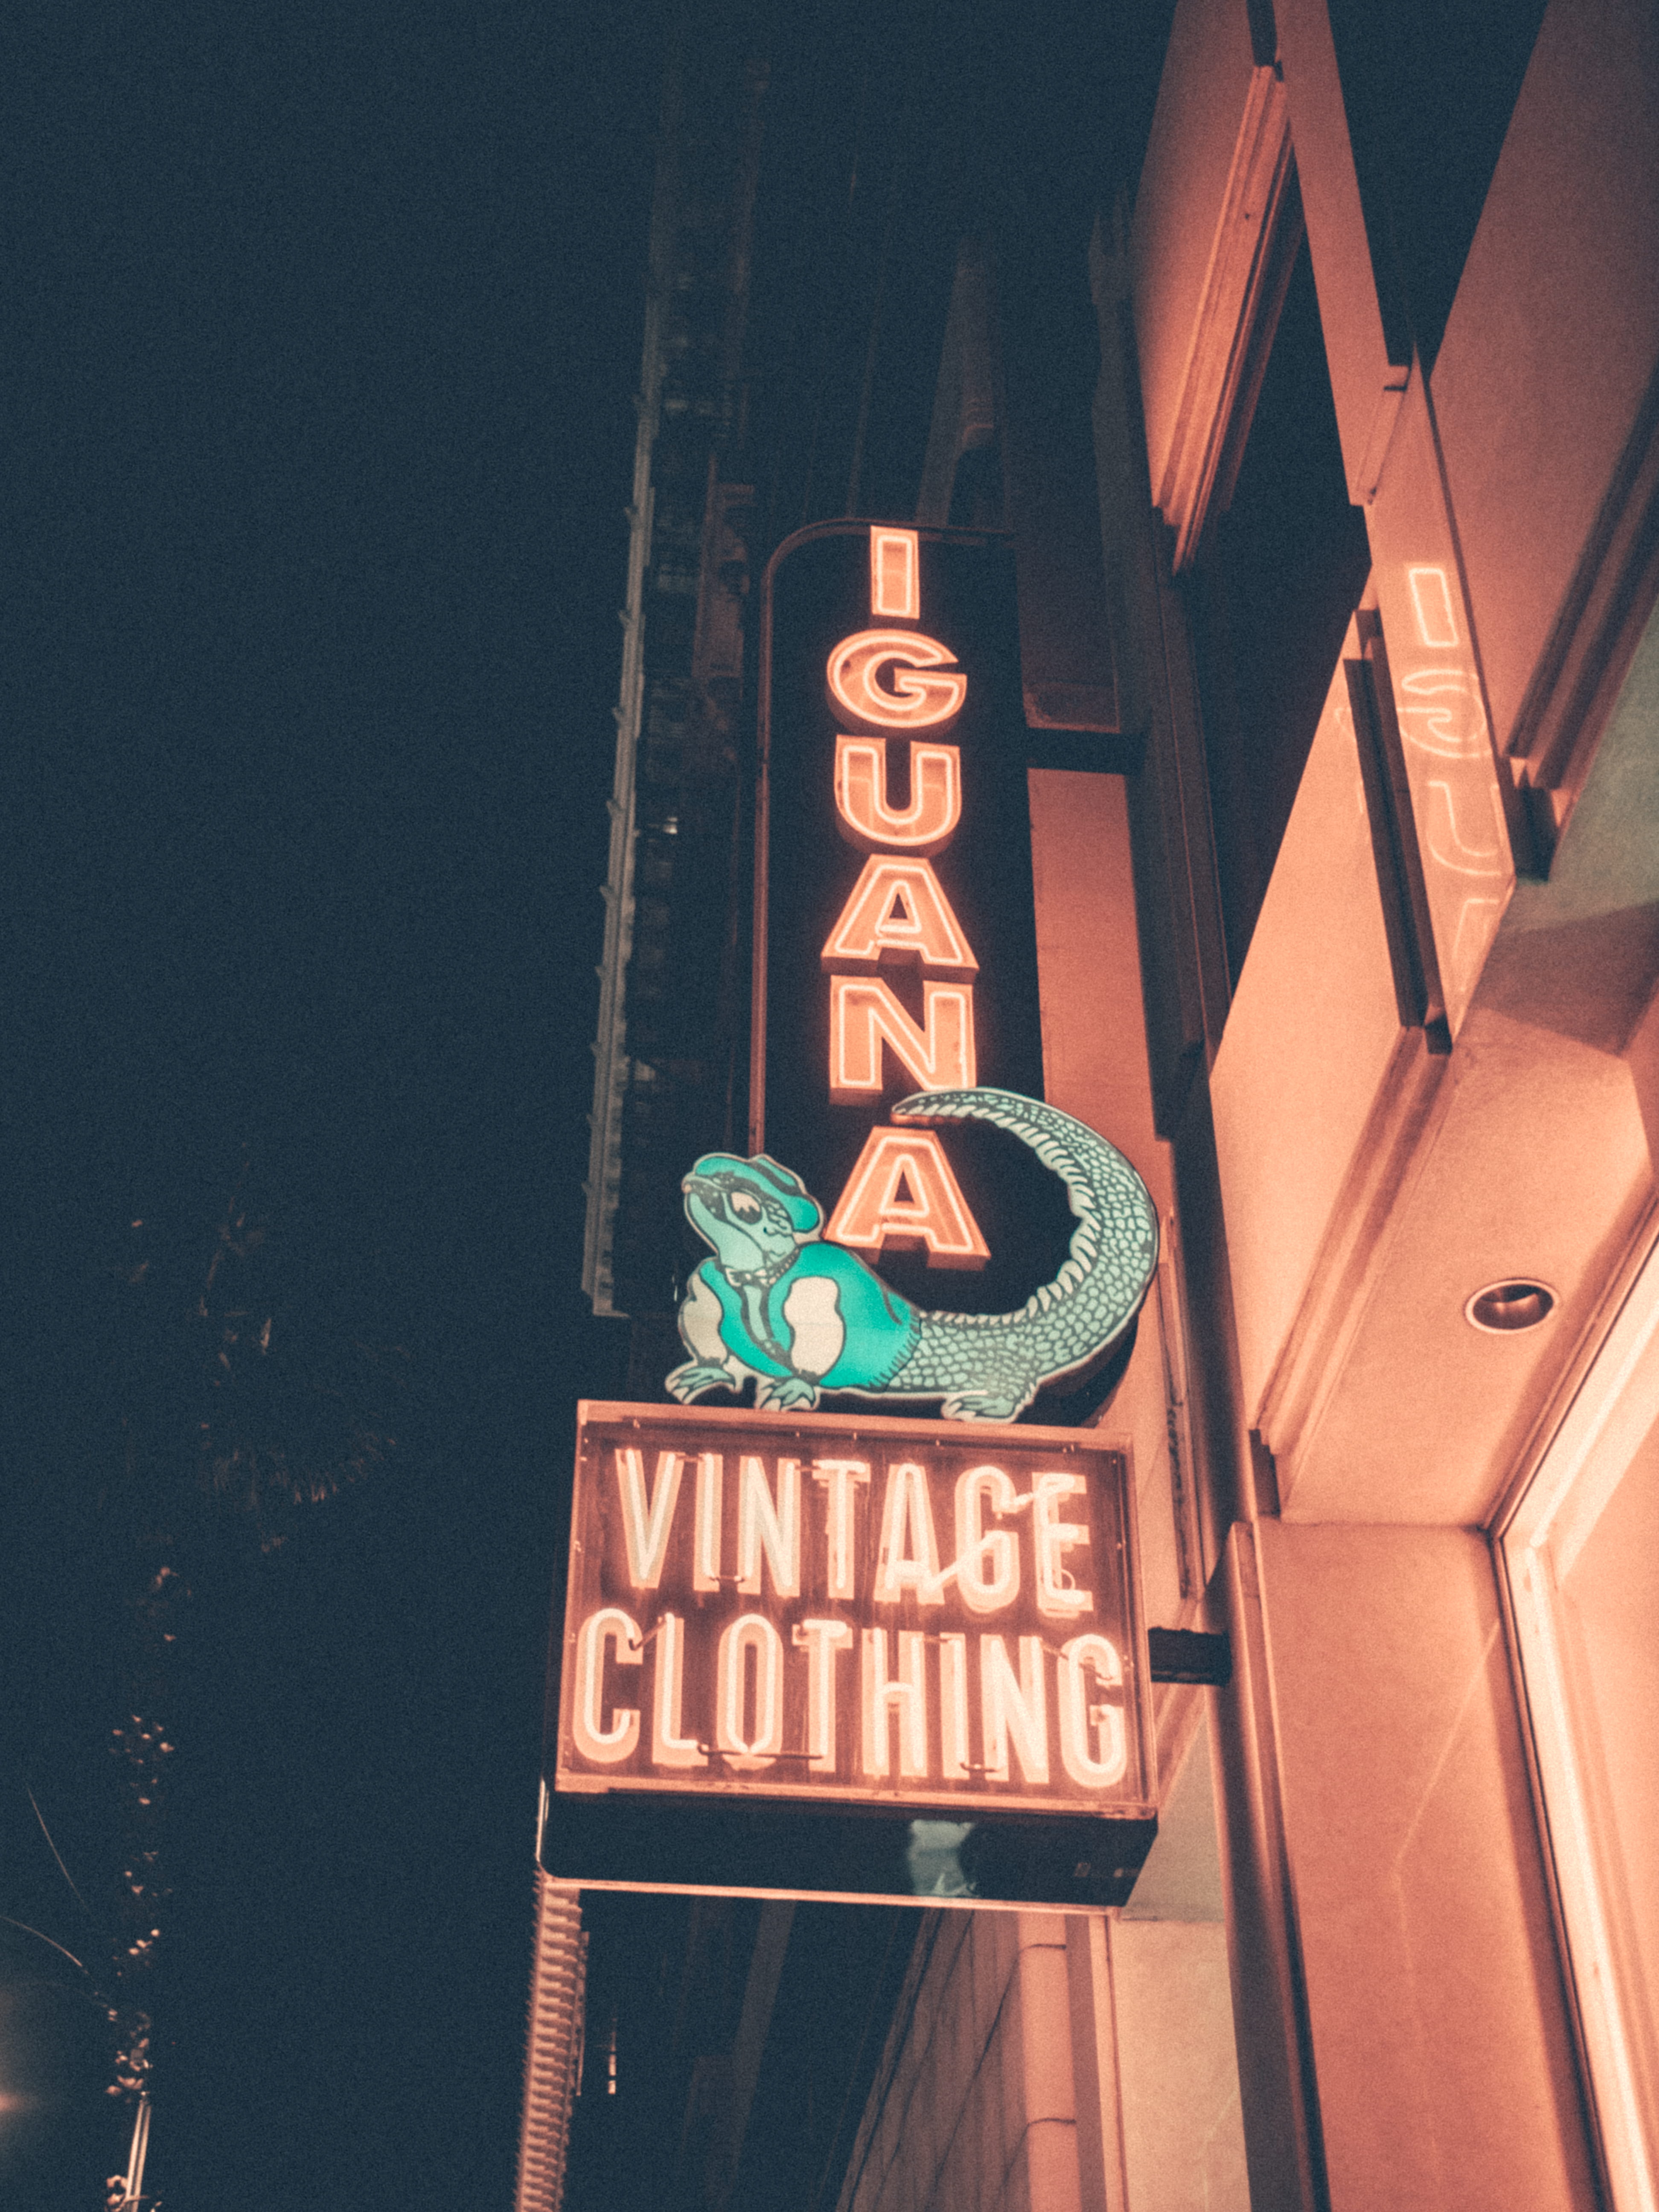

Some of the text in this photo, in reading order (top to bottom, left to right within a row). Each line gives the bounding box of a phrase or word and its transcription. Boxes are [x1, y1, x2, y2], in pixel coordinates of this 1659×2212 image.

[820, 525, 992, 1262] IGUANA
[615, 1448, 1094, 1616] VINTAGE
[572, 1608, 1128, 1787] CLOTHING
